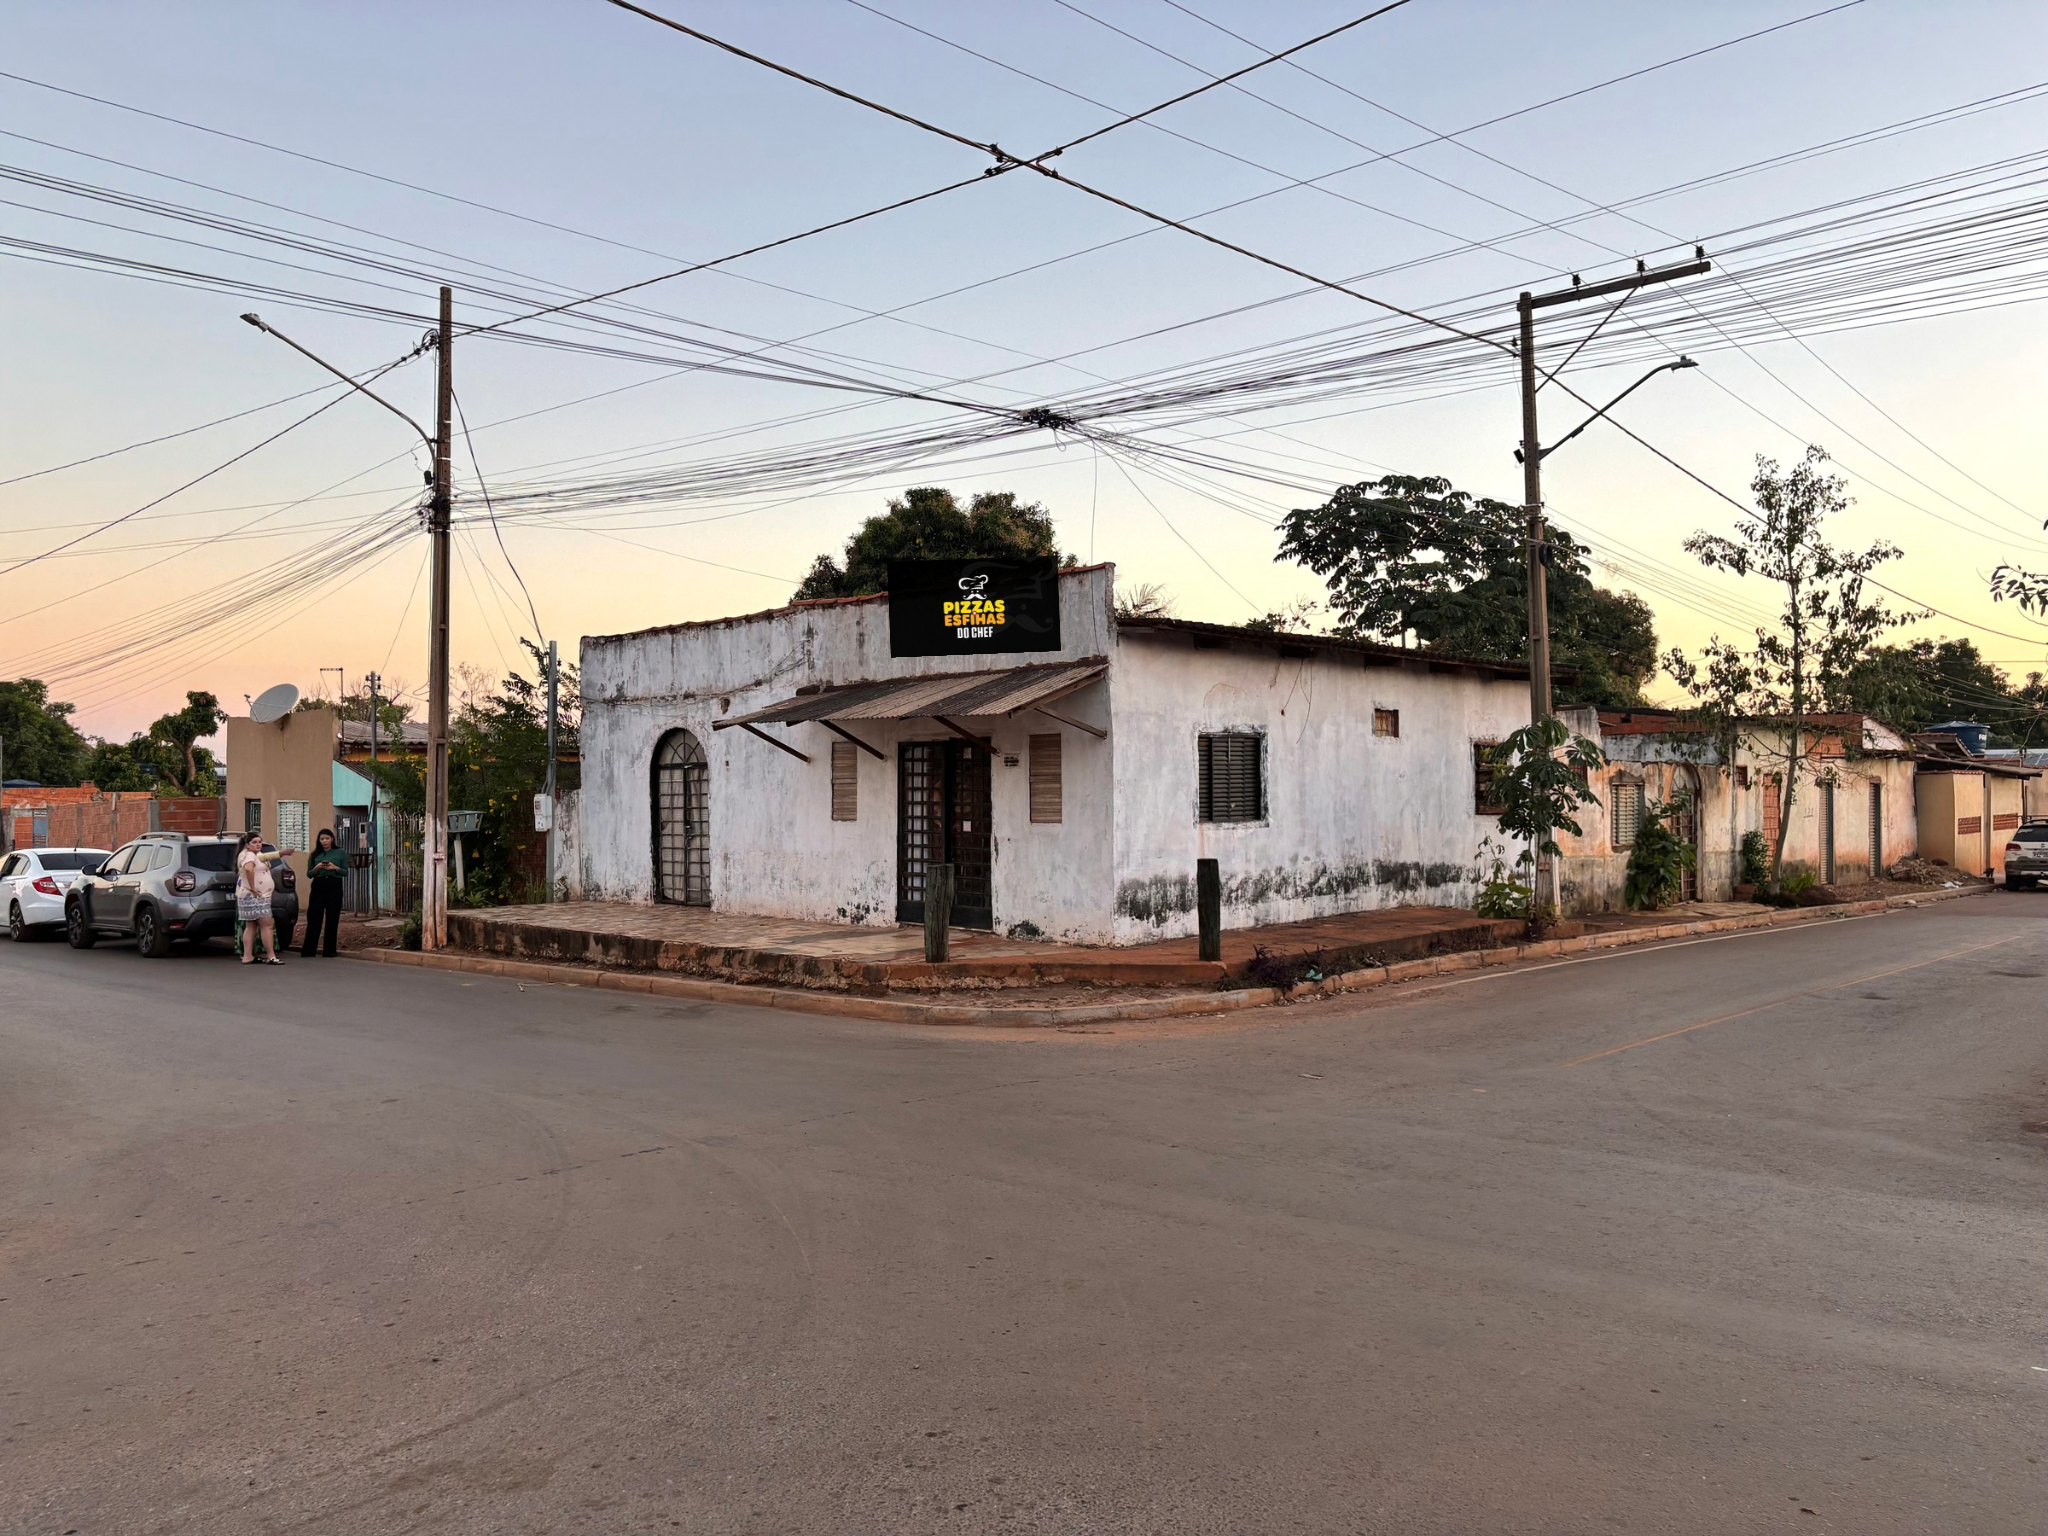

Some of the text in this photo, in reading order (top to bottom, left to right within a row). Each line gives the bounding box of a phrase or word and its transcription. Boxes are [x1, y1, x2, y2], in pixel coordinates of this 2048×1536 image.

[943, 599, 1006, 614] PIZZAS
[944, 613, 1006, 627] ESFIHAS
[957, 626, 993, 639] DO CHEF
